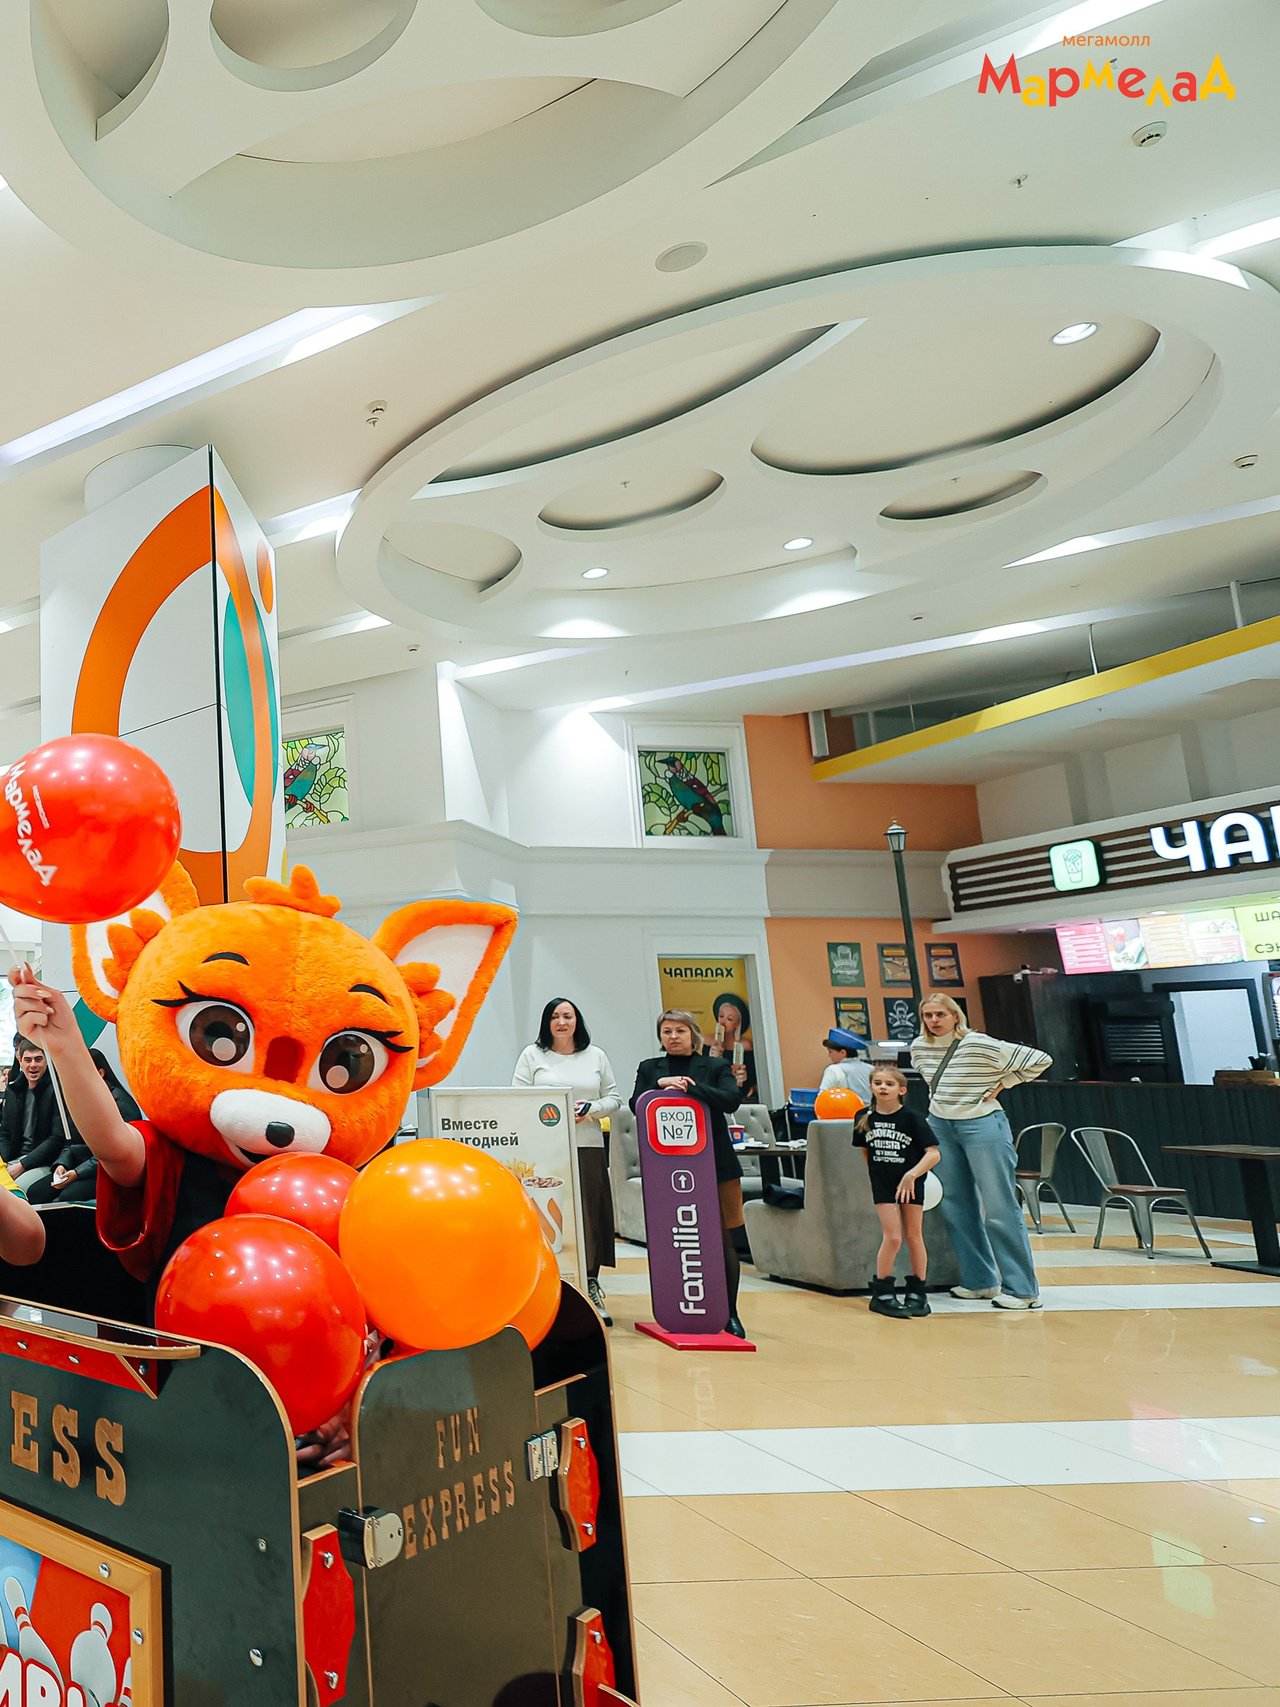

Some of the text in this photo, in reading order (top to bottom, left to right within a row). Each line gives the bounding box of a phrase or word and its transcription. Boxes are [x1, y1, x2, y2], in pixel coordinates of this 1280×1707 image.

[1149, 805, 1280, 872] ЧА
[663, 967, 734, 978] ЧАПАЛАХ
[441, 1118, 498, 1131] Вместе
[660, 1111, 694, 1123] ВХОД
[442, 1132, 519, 1148] годней
[671, 1203, 707, 1315] familia
[436, 1406, 480, 1469] FUN
[402, 1459, 516, 1560] EXPRESS
